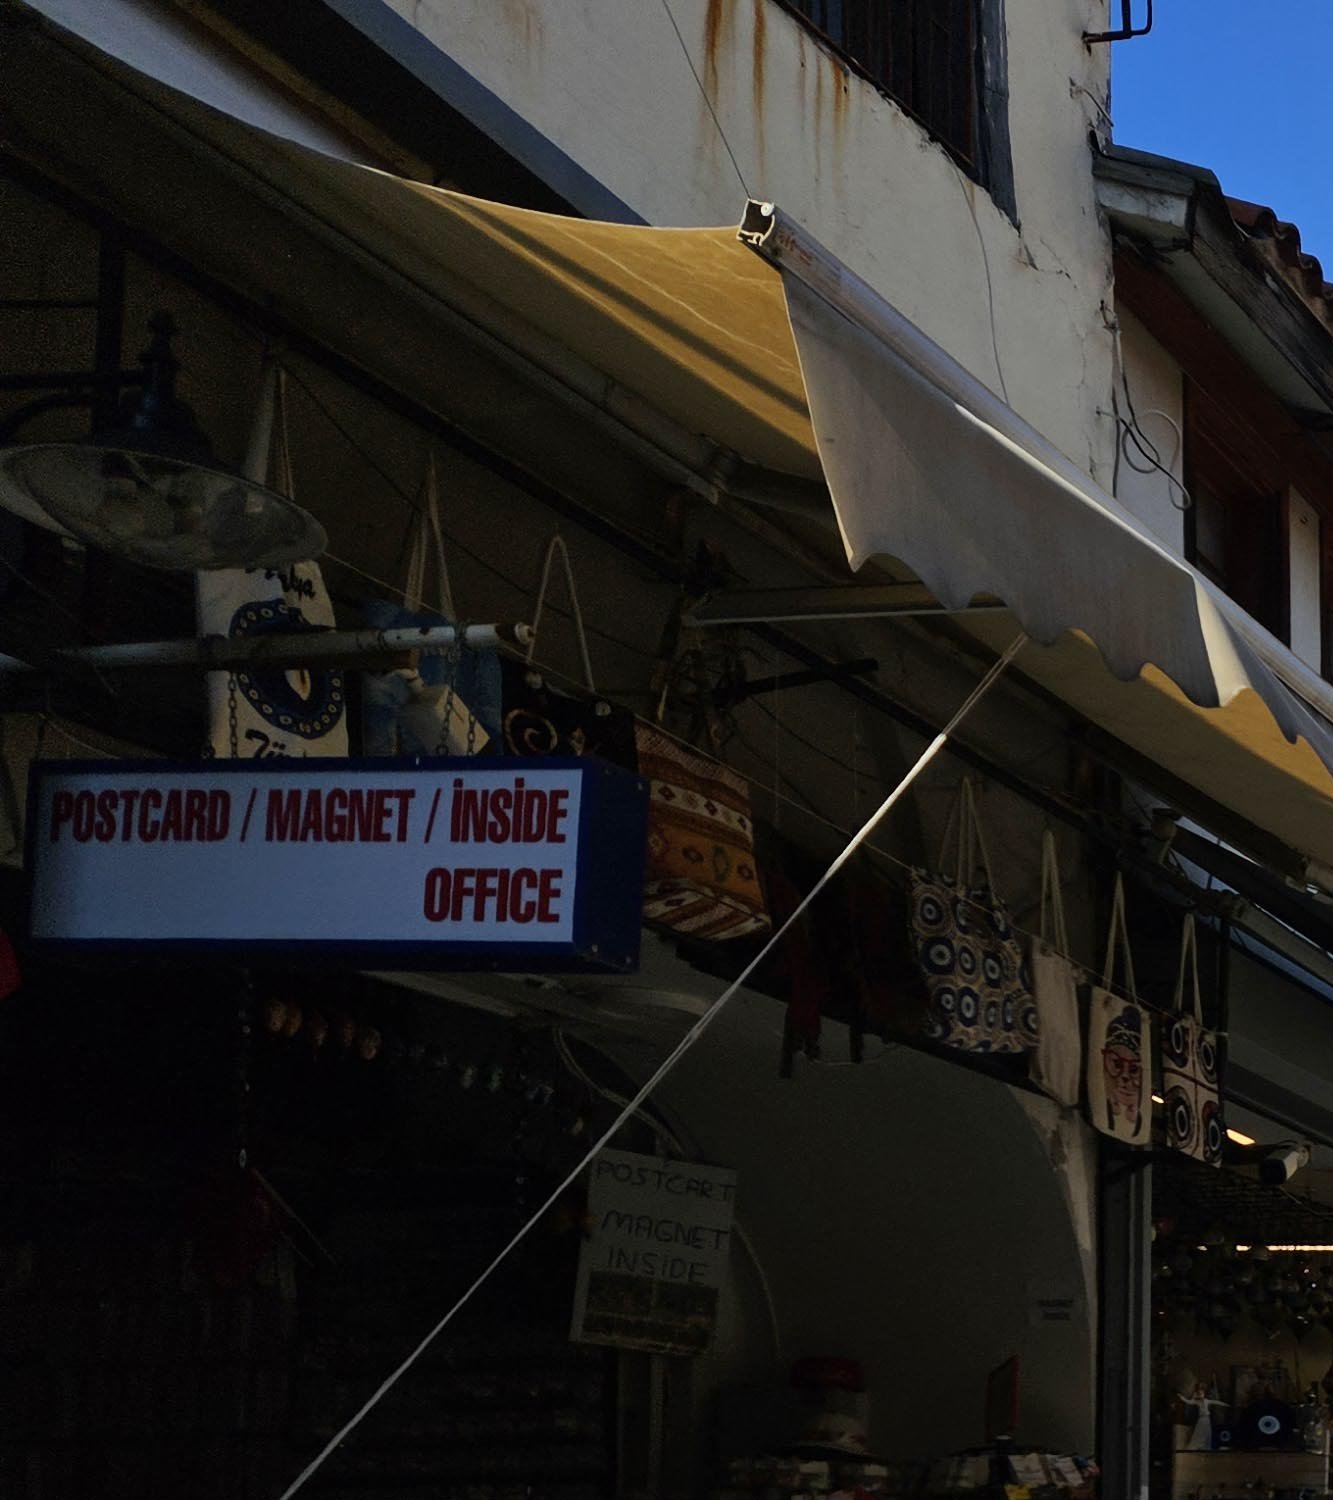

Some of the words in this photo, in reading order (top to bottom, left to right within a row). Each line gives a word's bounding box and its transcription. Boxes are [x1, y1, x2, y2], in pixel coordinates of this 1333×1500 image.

[50, 788, 230, 844] POSTCARD
[241, 788, 256, 843] /
[266, 788, 414, 844] MAGNET
[425, 788, 441, 843] /
[425, 867, 562, 922] OFFICE
[602, 1209, 729, 1250] MAGNET
